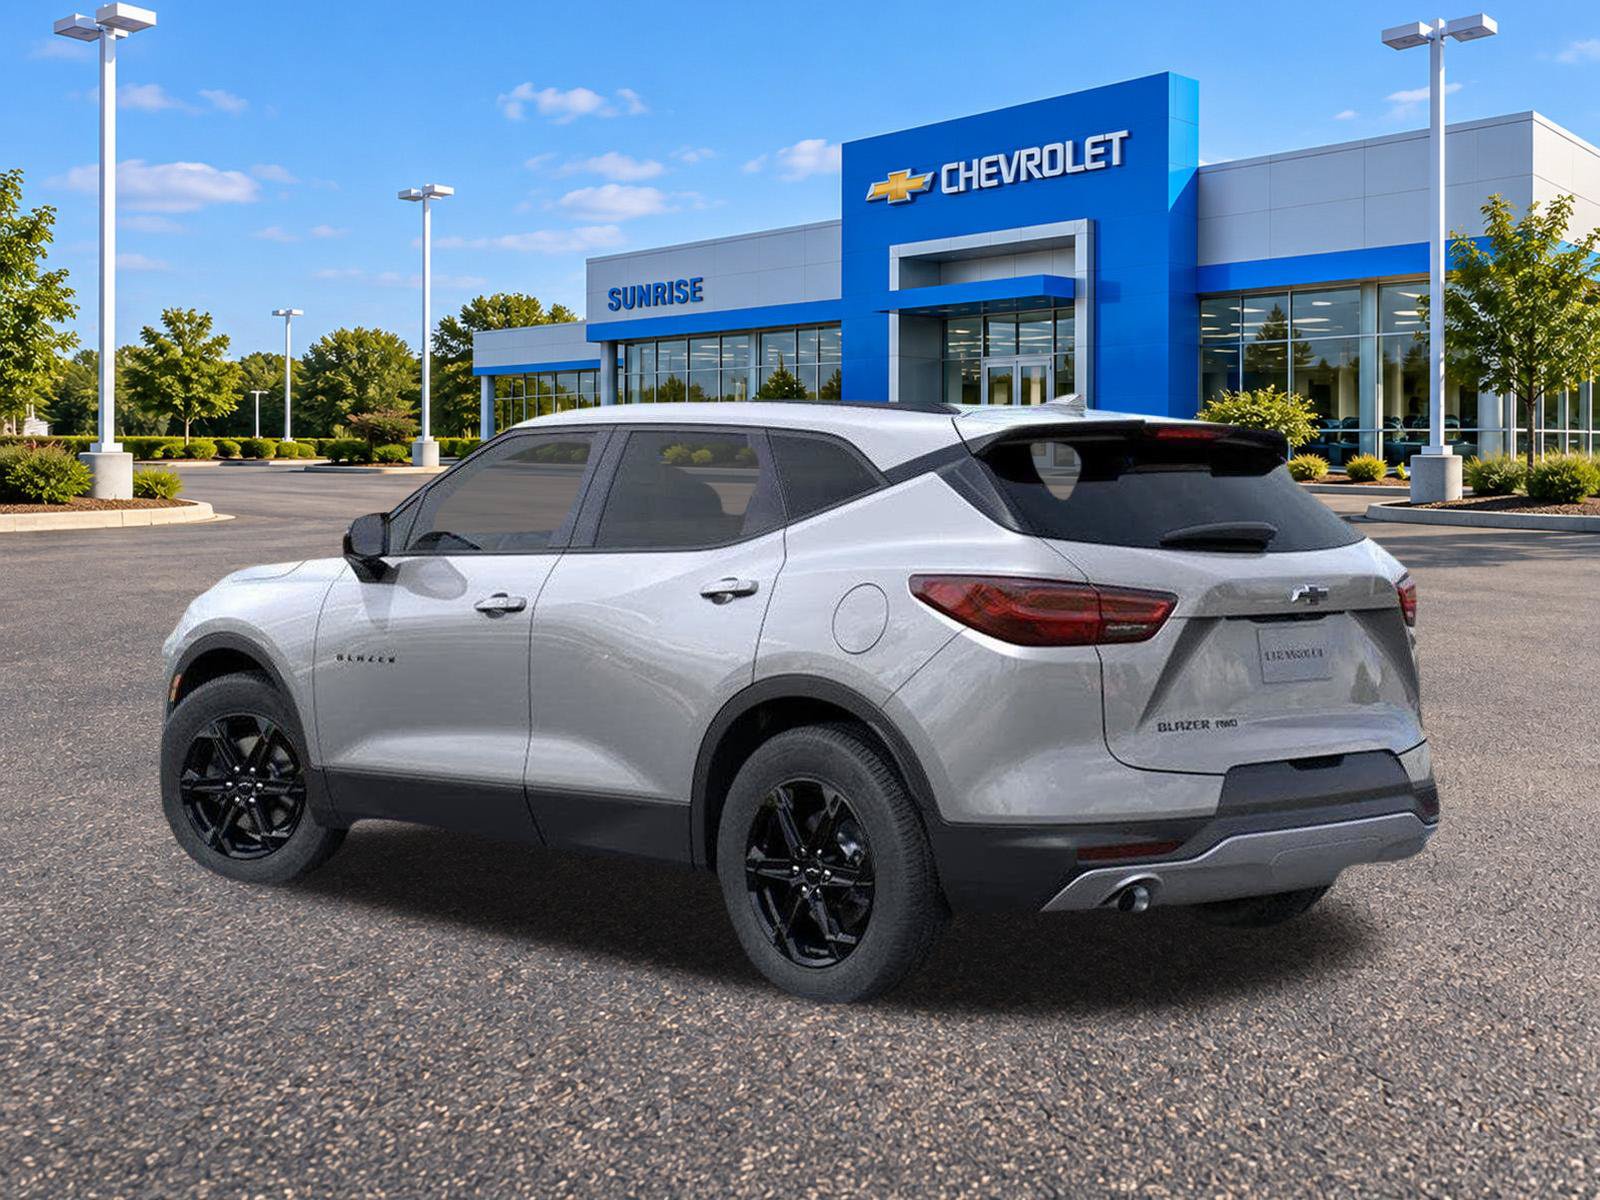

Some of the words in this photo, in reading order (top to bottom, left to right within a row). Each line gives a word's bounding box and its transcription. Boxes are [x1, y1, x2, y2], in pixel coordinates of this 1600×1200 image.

[941, 129, 1129, 194] CHEVROLET
[608, 277, 704, 312] SUNRISE
[1157, 719, 1210, 732] BLAZER
